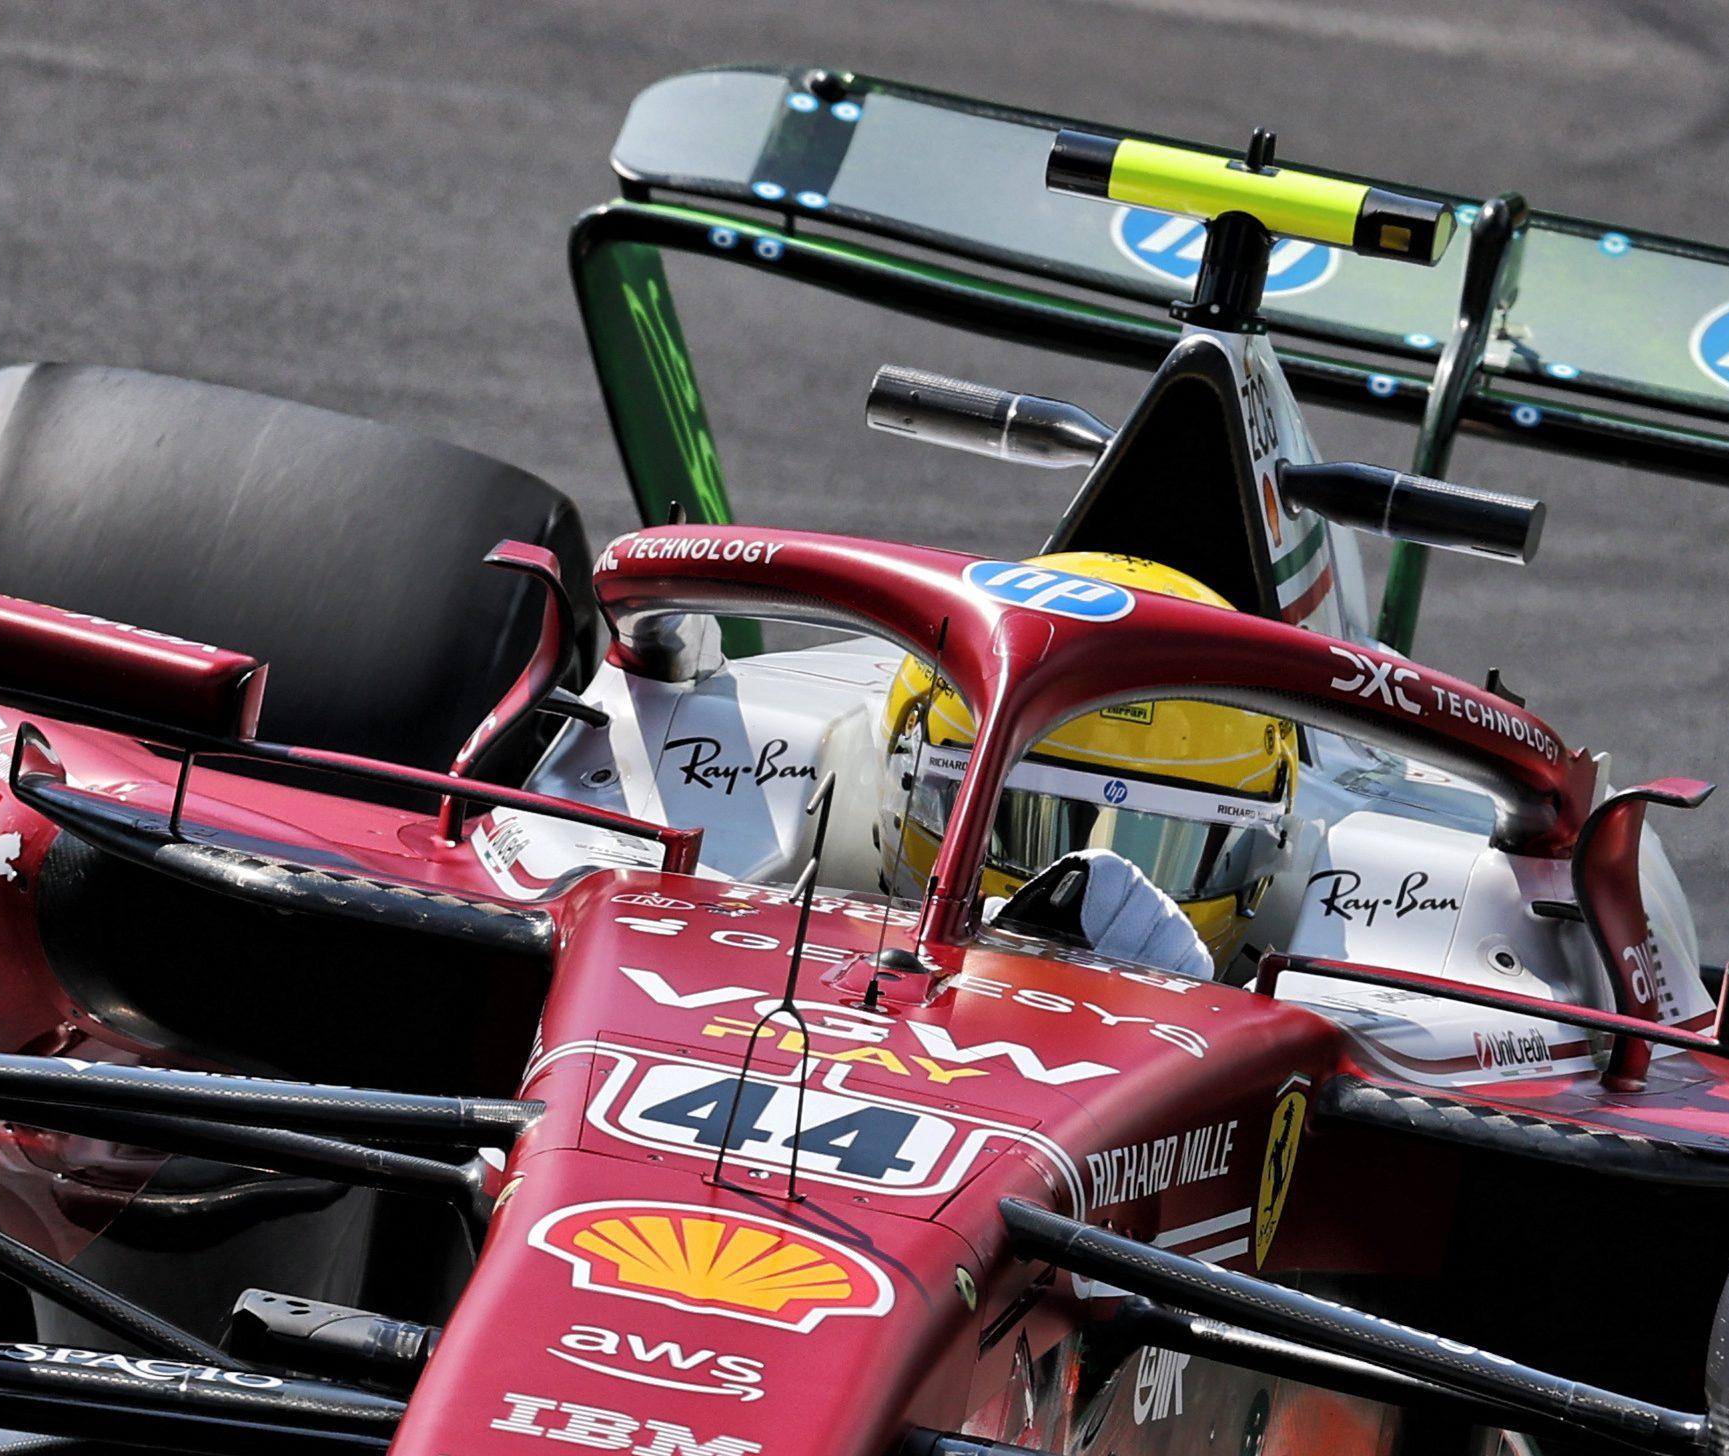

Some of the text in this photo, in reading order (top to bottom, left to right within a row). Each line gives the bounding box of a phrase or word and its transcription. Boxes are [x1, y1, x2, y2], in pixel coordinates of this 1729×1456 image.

[627, 537, 784, 564] TECHNOLOGY
[985, 562, 1117, 608] hp
[1329, 645, 1559, 764] DXC TECHNOLOGY
[929, 756, 968, 770] RICHARD
[1105, 779, 1127, 805] hp
[618, 966, 1122, 1085] VGW
[710, 930, 1209, 1058] GEESYS
[701, 1017, 990, 1084] PLAY
[1491, 1027, 1551, 1068] UniCredit
[639, 1077, 915, 1180] 44
[1089, 1120, 1239, 1210] RICHARD MILLE
[559, 1324, 766, 1385] aws
